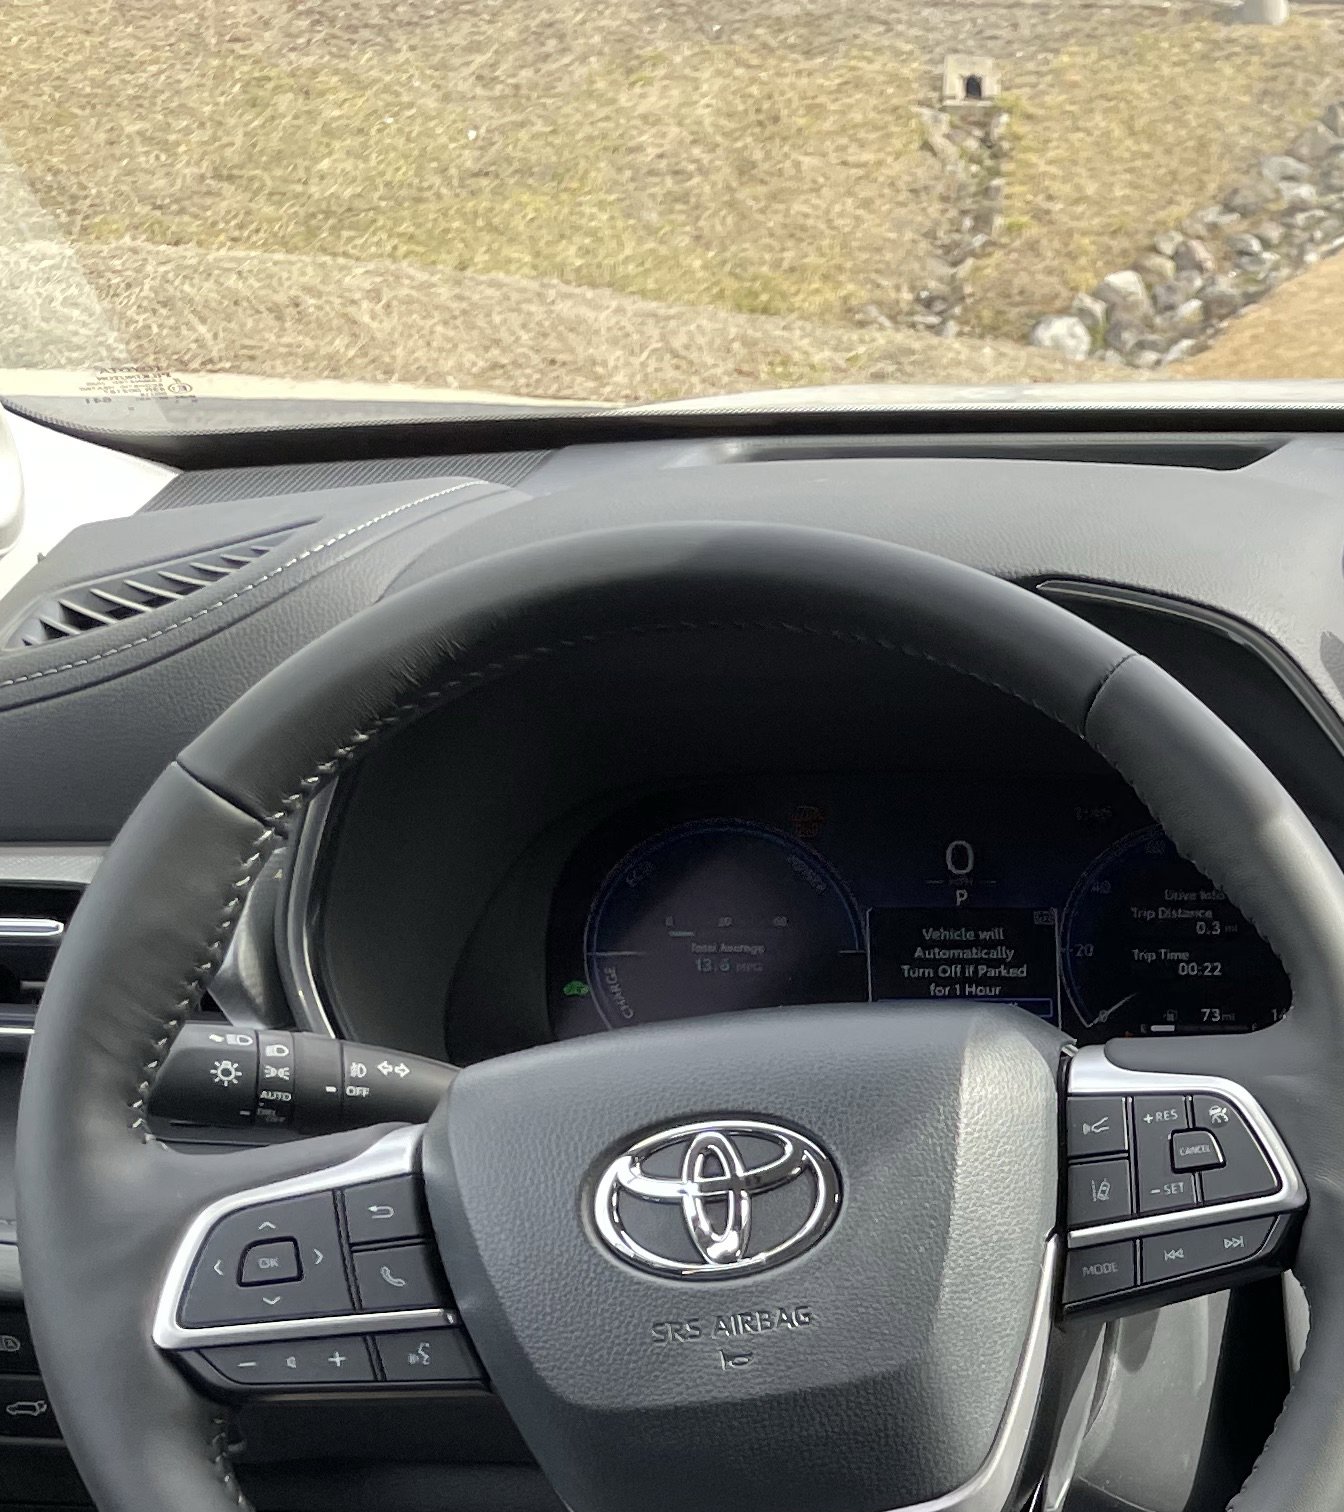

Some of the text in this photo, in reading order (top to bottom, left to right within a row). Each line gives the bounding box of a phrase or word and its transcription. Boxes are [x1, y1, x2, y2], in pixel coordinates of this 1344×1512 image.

[945, 840, 975, 875] 0
[956, 888, 969, 906] P
[1131, 907, 1213, 920] Trip Distance
[922, 927, 1005, 940] Vehicle will
[1195, 921, 1221, 936] 0.3
[913, 946, 1015, 961] Automatically
[1131, 949, 1190, 963] Trip Time
[901, 963, 1028, 978] Turn Off if Parked
[1177, 961, 1222, 976] 00:22
[603, 966, 634, 1020] CHARGE
[929, 982, 1002, 996] for 1 Hour
[1200, 1008, 1220, 1022] 73
[260, 1090, 292, 1102] AUTO
[346, 1085, 370, 1098] OFF
[258, 1256, 280, 1269] OK
[1082, 1262, 1118, 1277] MODE
[651, 1305, 816, 1345] SRS AIRBAG
